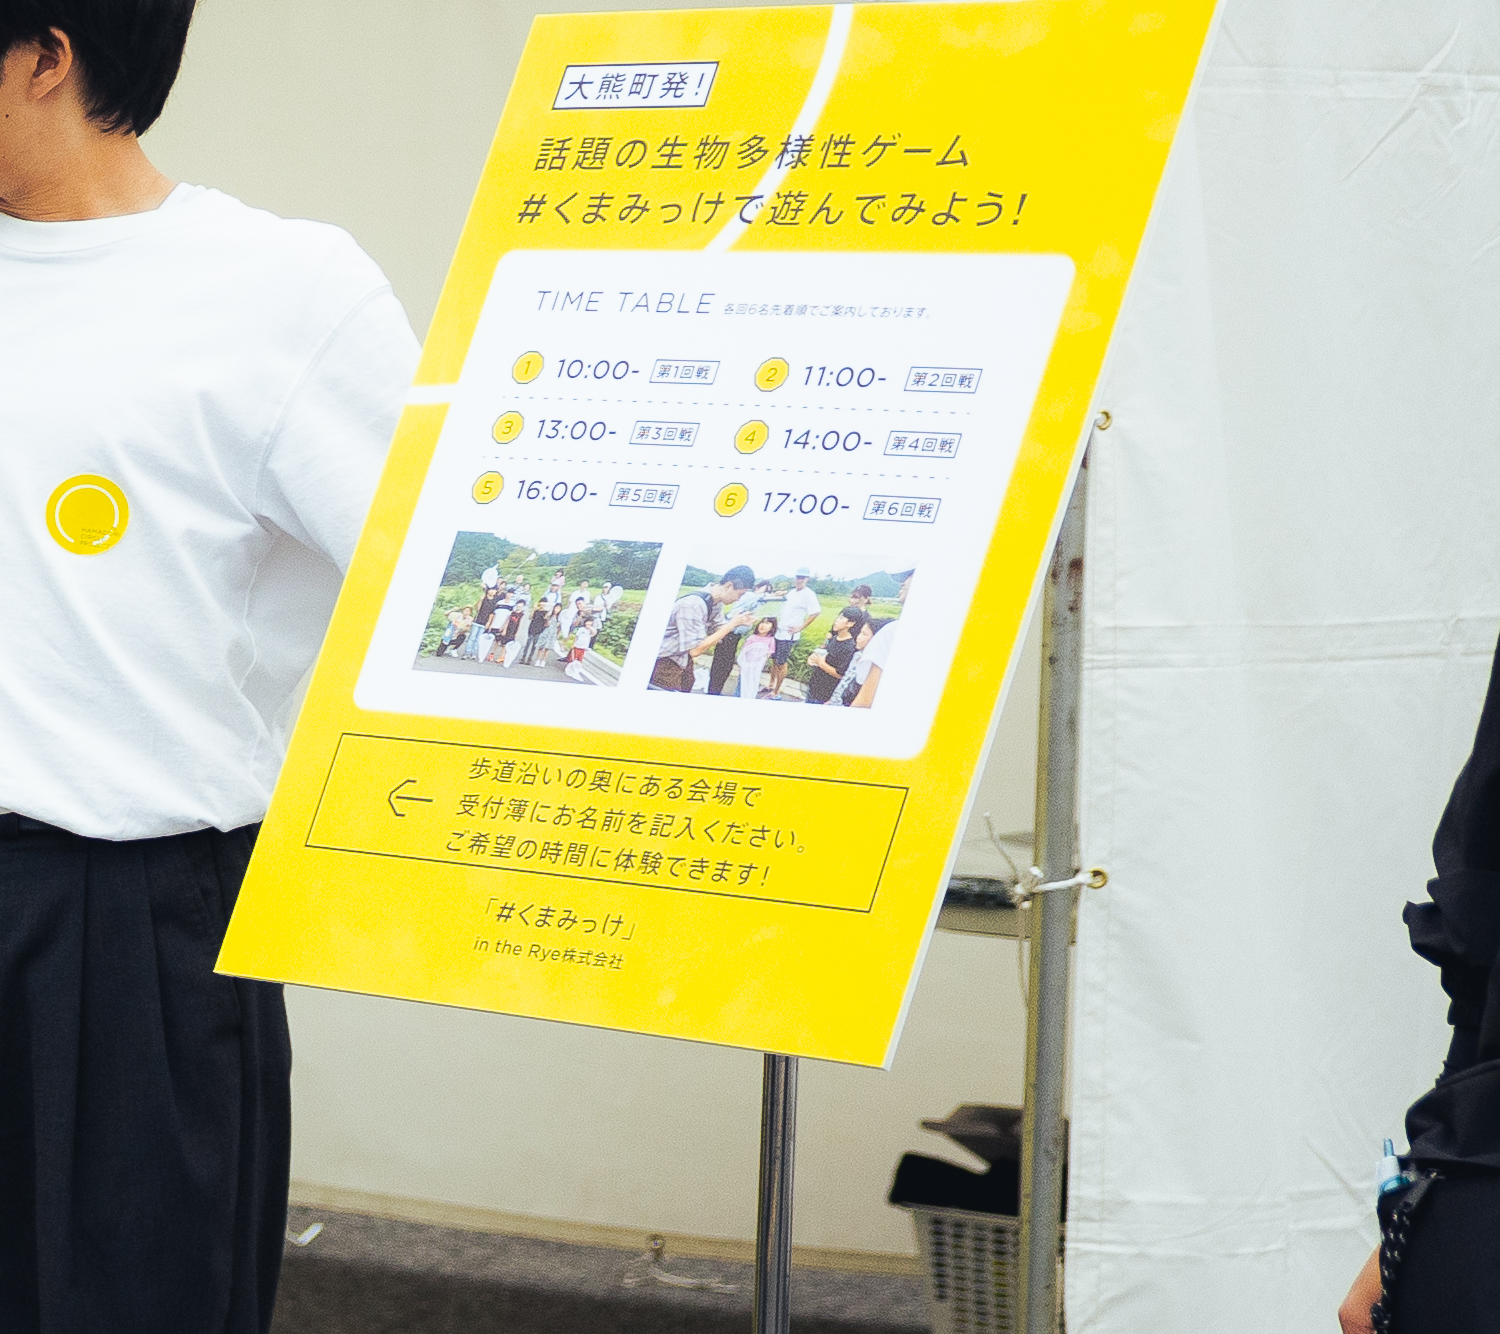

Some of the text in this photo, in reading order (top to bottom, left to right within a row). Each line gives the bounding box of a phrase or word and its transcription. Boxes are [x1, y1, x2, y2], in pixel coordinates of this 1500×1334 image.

[533, 134, 970, 171] 話題の生物多様性ゲーム
[537, 291, 716, 315] TIME TABLE
[523, 359, 711, 380] 1 10:00- 第1回戦
[765, 366, 975, 388] 2 11:00- 第2回戦
[501, 420, 694, 442] 3 13:00- 第3回戦
[744, 429, 956, 453] 4 14:00- 第4回戦
[481, 480, 674, 504] 5 16:00- 第5回戦
[724, 492, 935, 518] 6 17:00- 第6回戦
[467, 756, 763, 808] 歩道沿いの奥にある会場で
[455, 793, 806, 855] 受付簿にお名前を記入ください。
[473, 936, 489, 951] in
[494, 939, 523, 956] the
